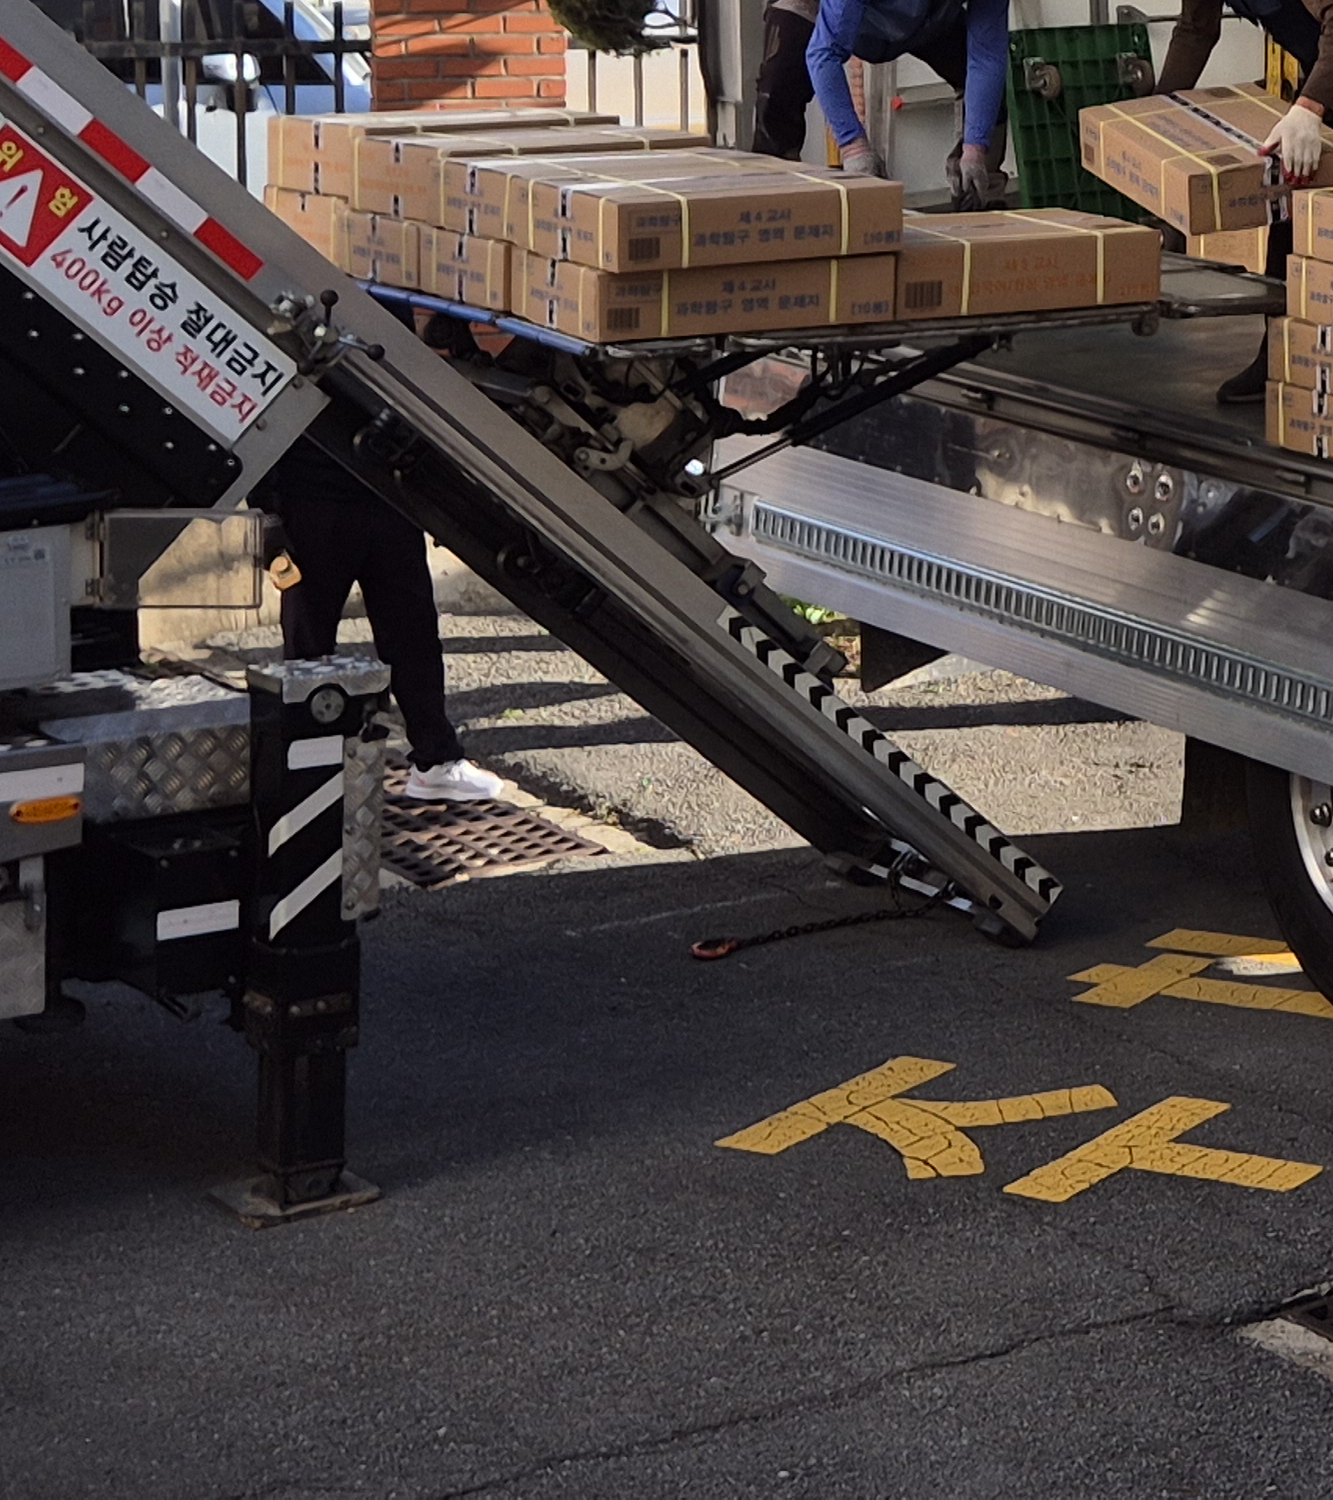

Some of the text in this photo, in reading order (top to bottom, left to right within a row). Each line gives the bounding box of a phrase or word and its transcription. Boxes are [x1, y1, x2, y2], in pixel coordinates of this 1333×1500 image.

[49, 185, 78, 218] 험
[50, 248, 258, 424] 400kg 이상 적재금지
[77, 217, 285, 397] 사람탑승 절대금지
